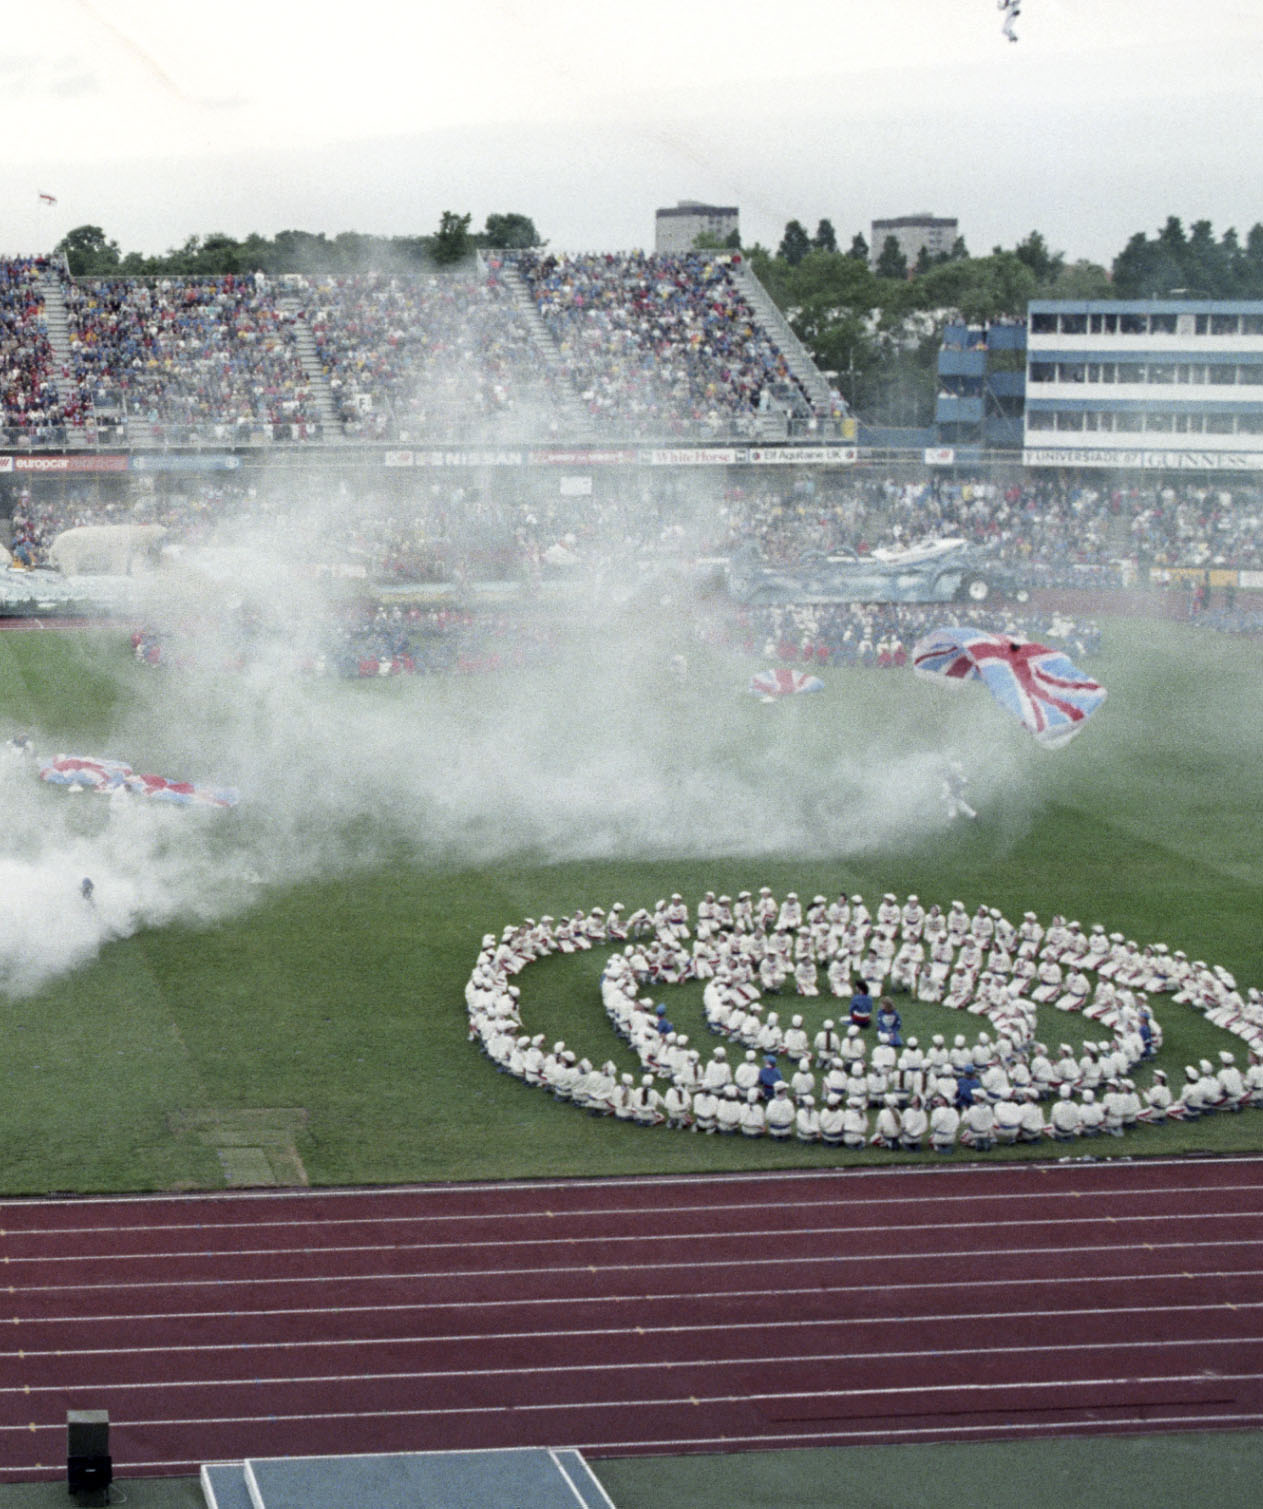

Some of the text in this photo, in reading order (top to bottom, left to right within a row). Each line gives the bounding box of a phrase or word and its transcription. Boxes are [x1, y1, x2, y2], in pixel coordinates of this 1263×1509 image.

[16, 458, 69, 471] europcar
[445, 452, 522, 465] NISSAN
[1147, 453, 1247, 467] GUINNESS
